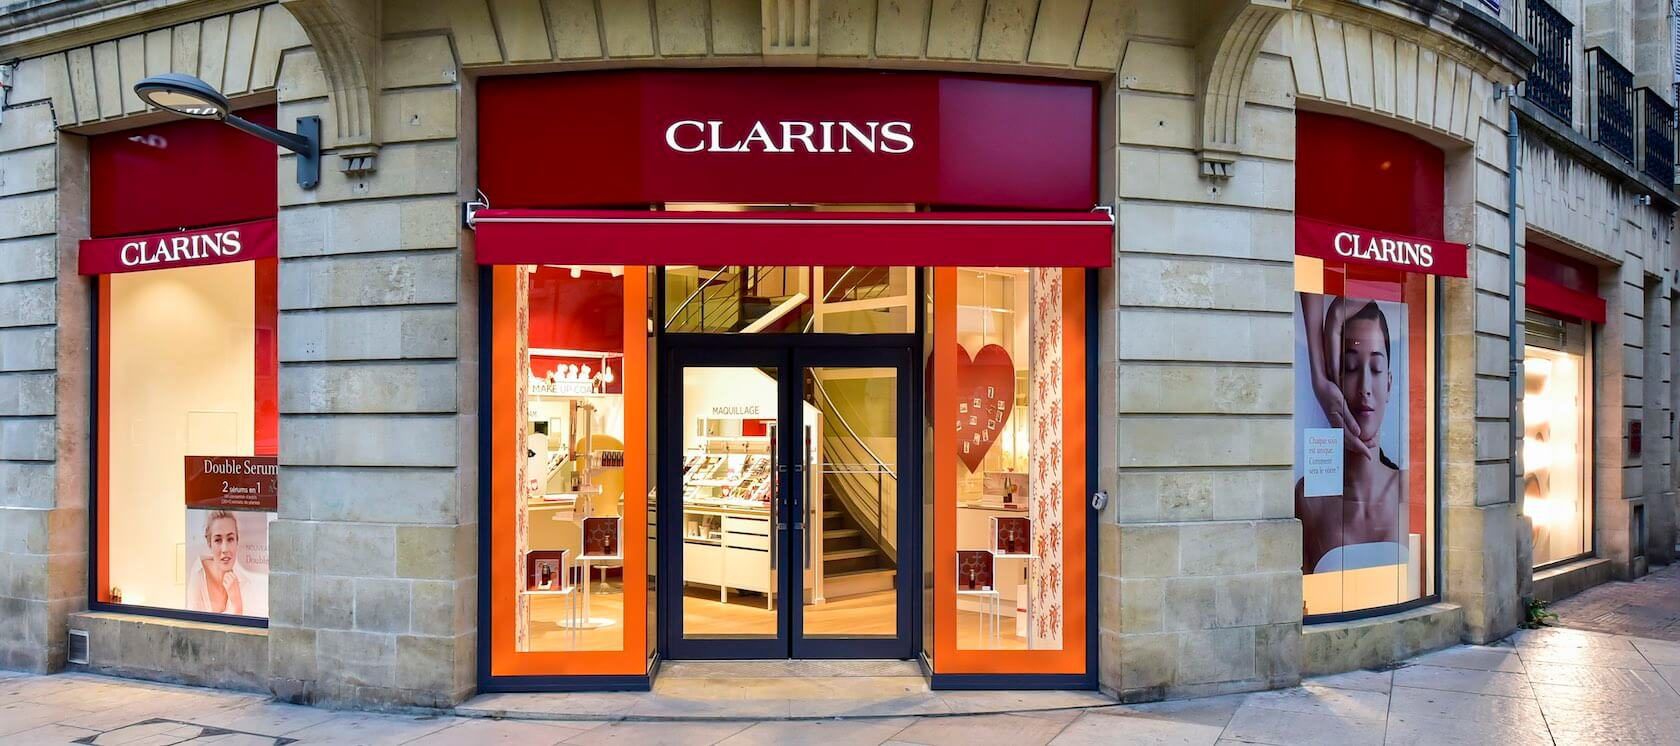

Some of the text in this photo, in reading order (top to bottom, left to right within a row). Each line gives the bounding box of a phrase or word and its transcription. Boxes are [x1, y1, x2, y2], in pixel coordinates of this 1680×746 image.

[665, 120, 914, 154] CLARINS
[120, 230, 241, 266] CLARINS
[1334, 232, 1434, 267] CLARINS
[532, 385, 557, 393] MAKE
[712, 406, 760, 415] MAQUILLAGE
[204, 459, 278, 475] Double Serum
[222, 480, 229, 493] 2
[229, 485, 249, 494] sérums
[256, 481, 261, 494] 1
